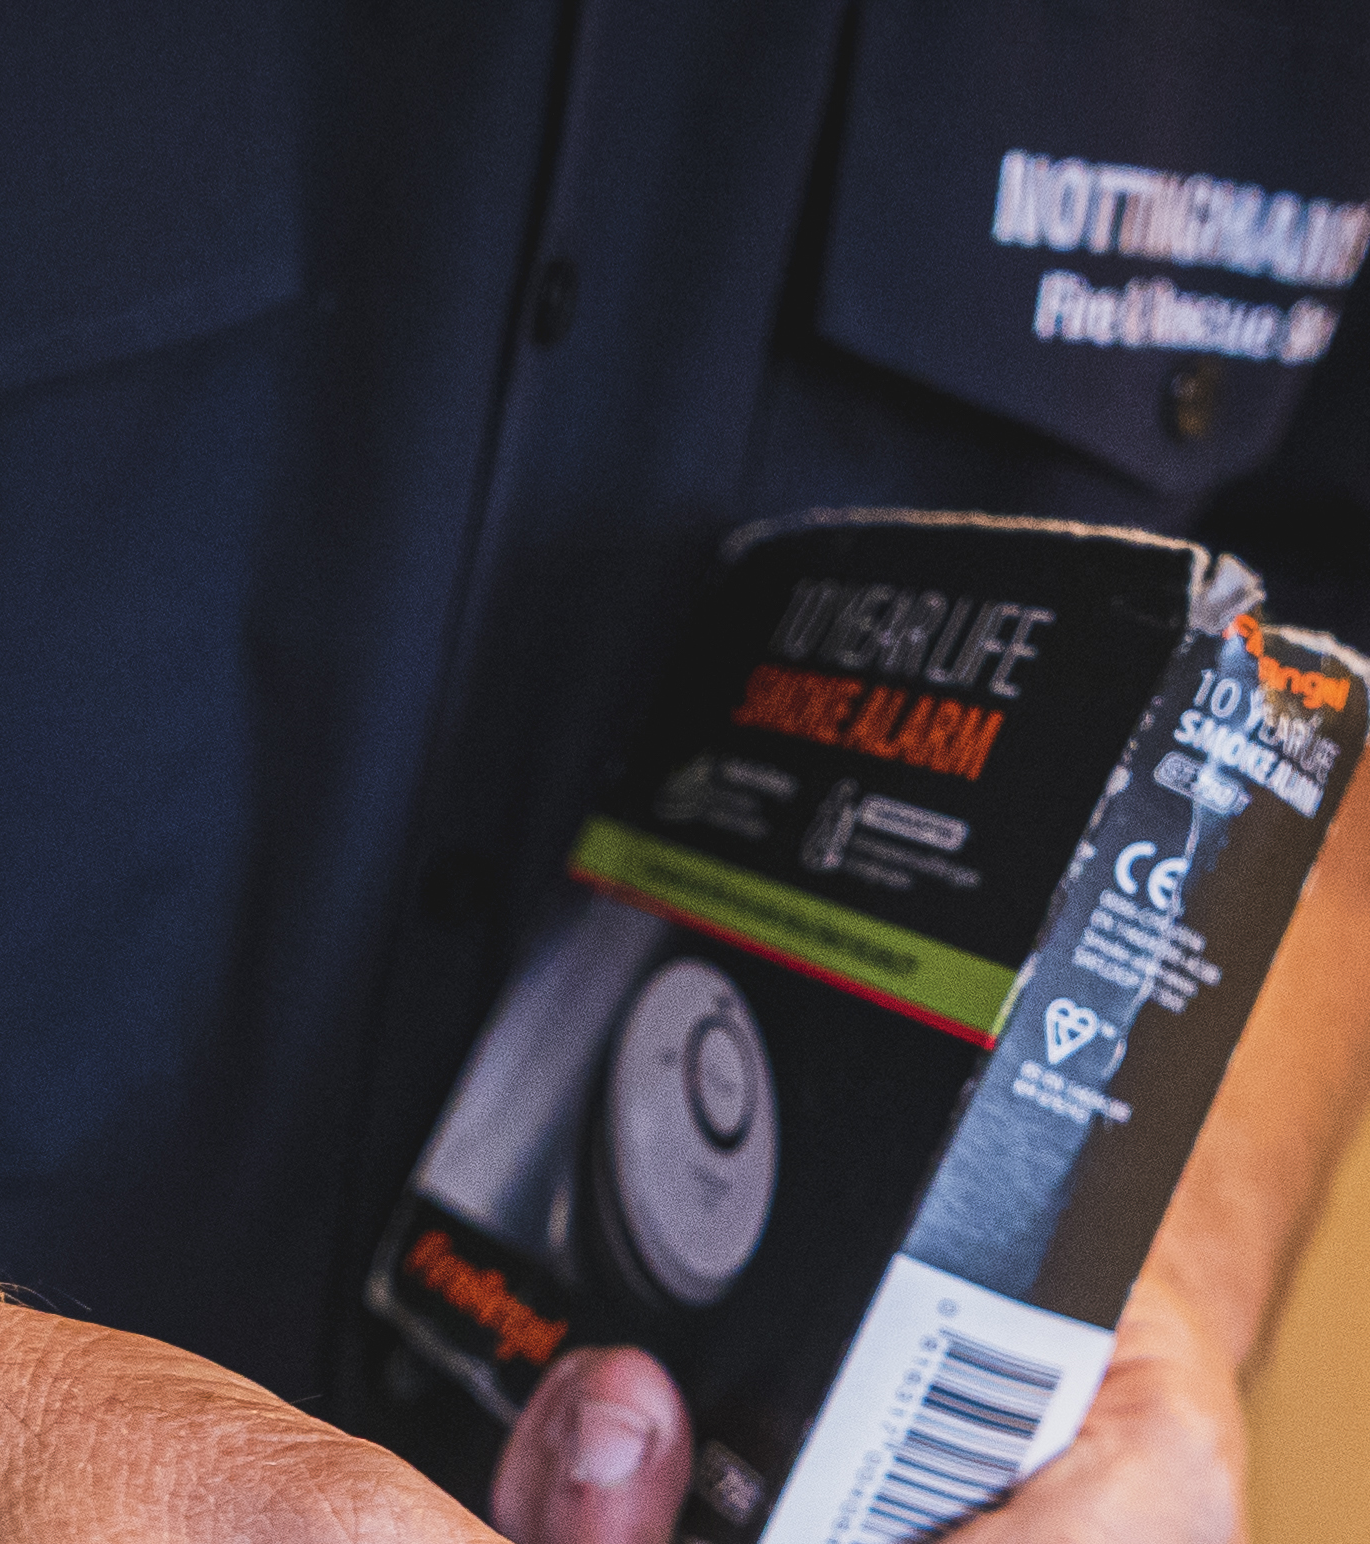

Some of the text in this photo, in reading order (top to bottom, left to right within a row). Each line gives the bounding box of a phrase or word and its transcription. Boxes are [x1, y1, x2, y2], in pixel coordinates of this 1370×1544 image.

[927, 596, 1056, 698] LIFE
[1194, 668, 1243, 719] 10
[1174, 708, 1280, 787] SMOKE
